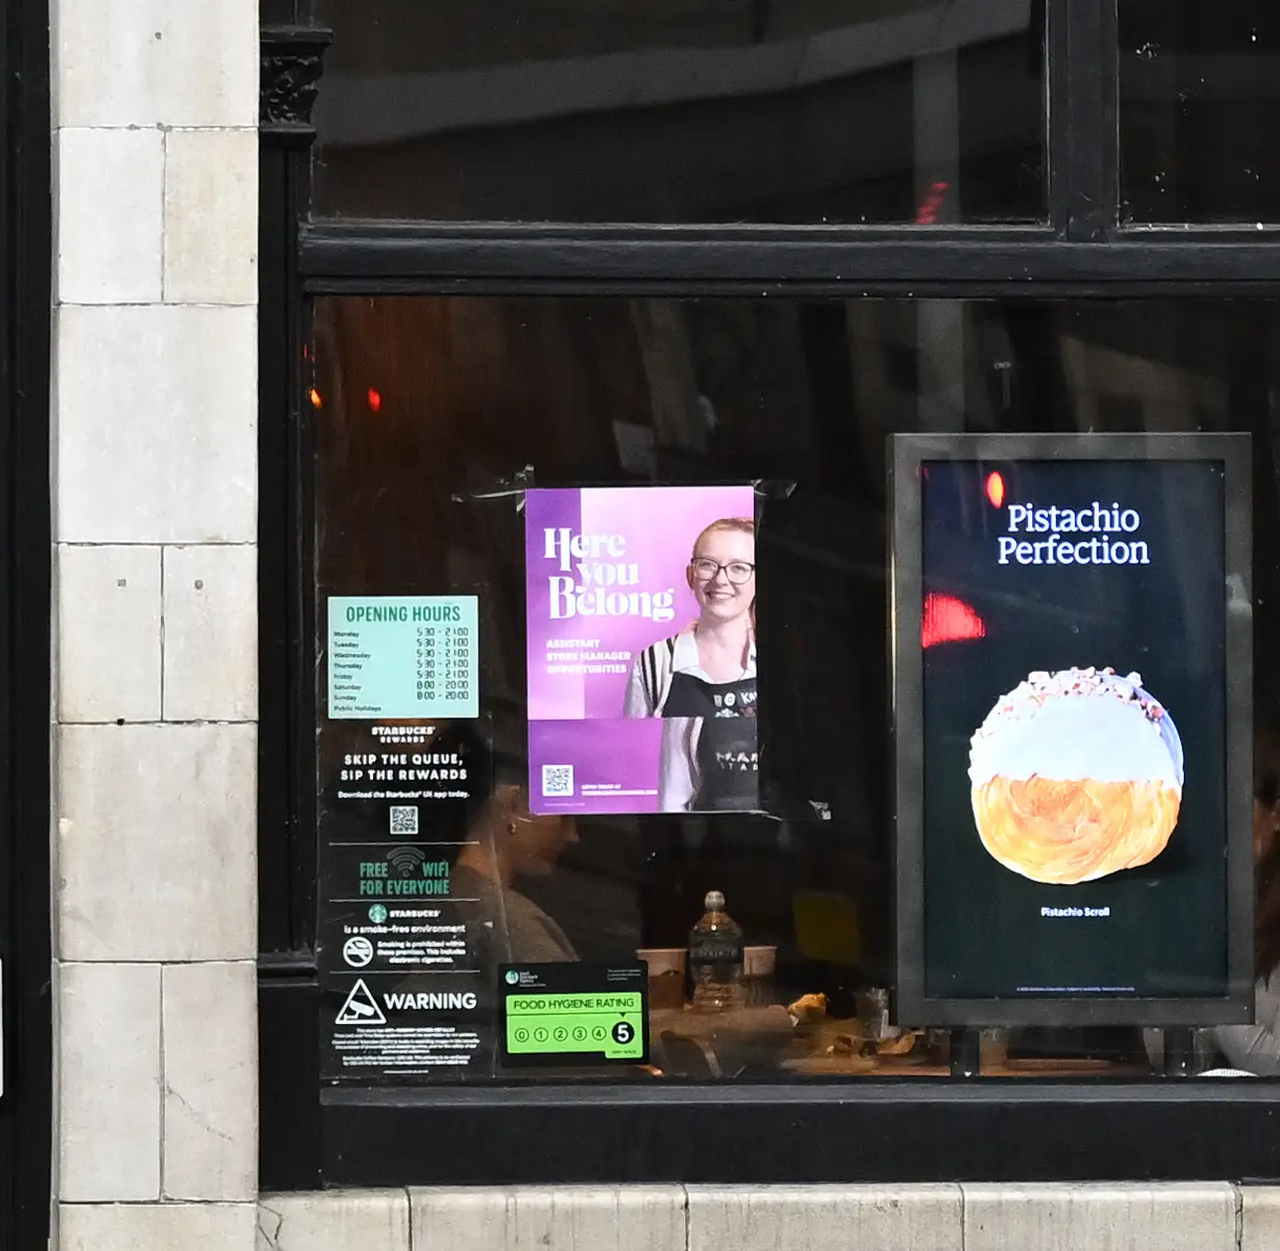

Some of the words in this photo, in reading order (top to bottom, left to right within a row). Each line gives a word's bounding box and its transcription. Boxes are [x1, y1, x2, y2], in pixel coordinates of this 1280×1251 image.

[1008, 501, 1140, 532] Pistachio
[543, 527, 626, 572] Here
[997, 533, 1150, 565] Perfection
[576, 562, 640, 594] you
[548, 576, 675, 622] Belong
[346, 606, 408, 622] OPENING
[412, 605, 461, 622] HOURS
[546, 639, 601, 649] ASSISTANT
[580, 651, 631, 661] MANAGER
[547, 664, 628, 674] OPPORTUNITIES
[344, 754, 377, 765] SKIP
[381, 754, 407, 765] THE
[412, 754, 464, 766] QUEUE,
[340, 770, 363, 780] SIP
[368, 770, 394, 780] THE
[398, 769, 467, 780] REWARDS
[360, 862, 388, 877] FREE
[422, 862, 449, 877] WIFI
[360, 880, 383, 895] FOR
[387, 879, 450, 895] EVERYONE
[1041, 907, 1083, 917] Pistachio
[1084, 907, 1110, 917] Scroll
[344, 925, 351, 934] is
[360, 925, 410, 934] smoke-free
[411, 925, 466, 934] environment
[383, 992, 477, 1010] WARNING
[513, 1000, 546, 1010] FOOD
[548, 999, 594, 1009] HYGIENE
[596, 997, 635, 1008] RATING
[617, 1024, 630, 1042] 5
